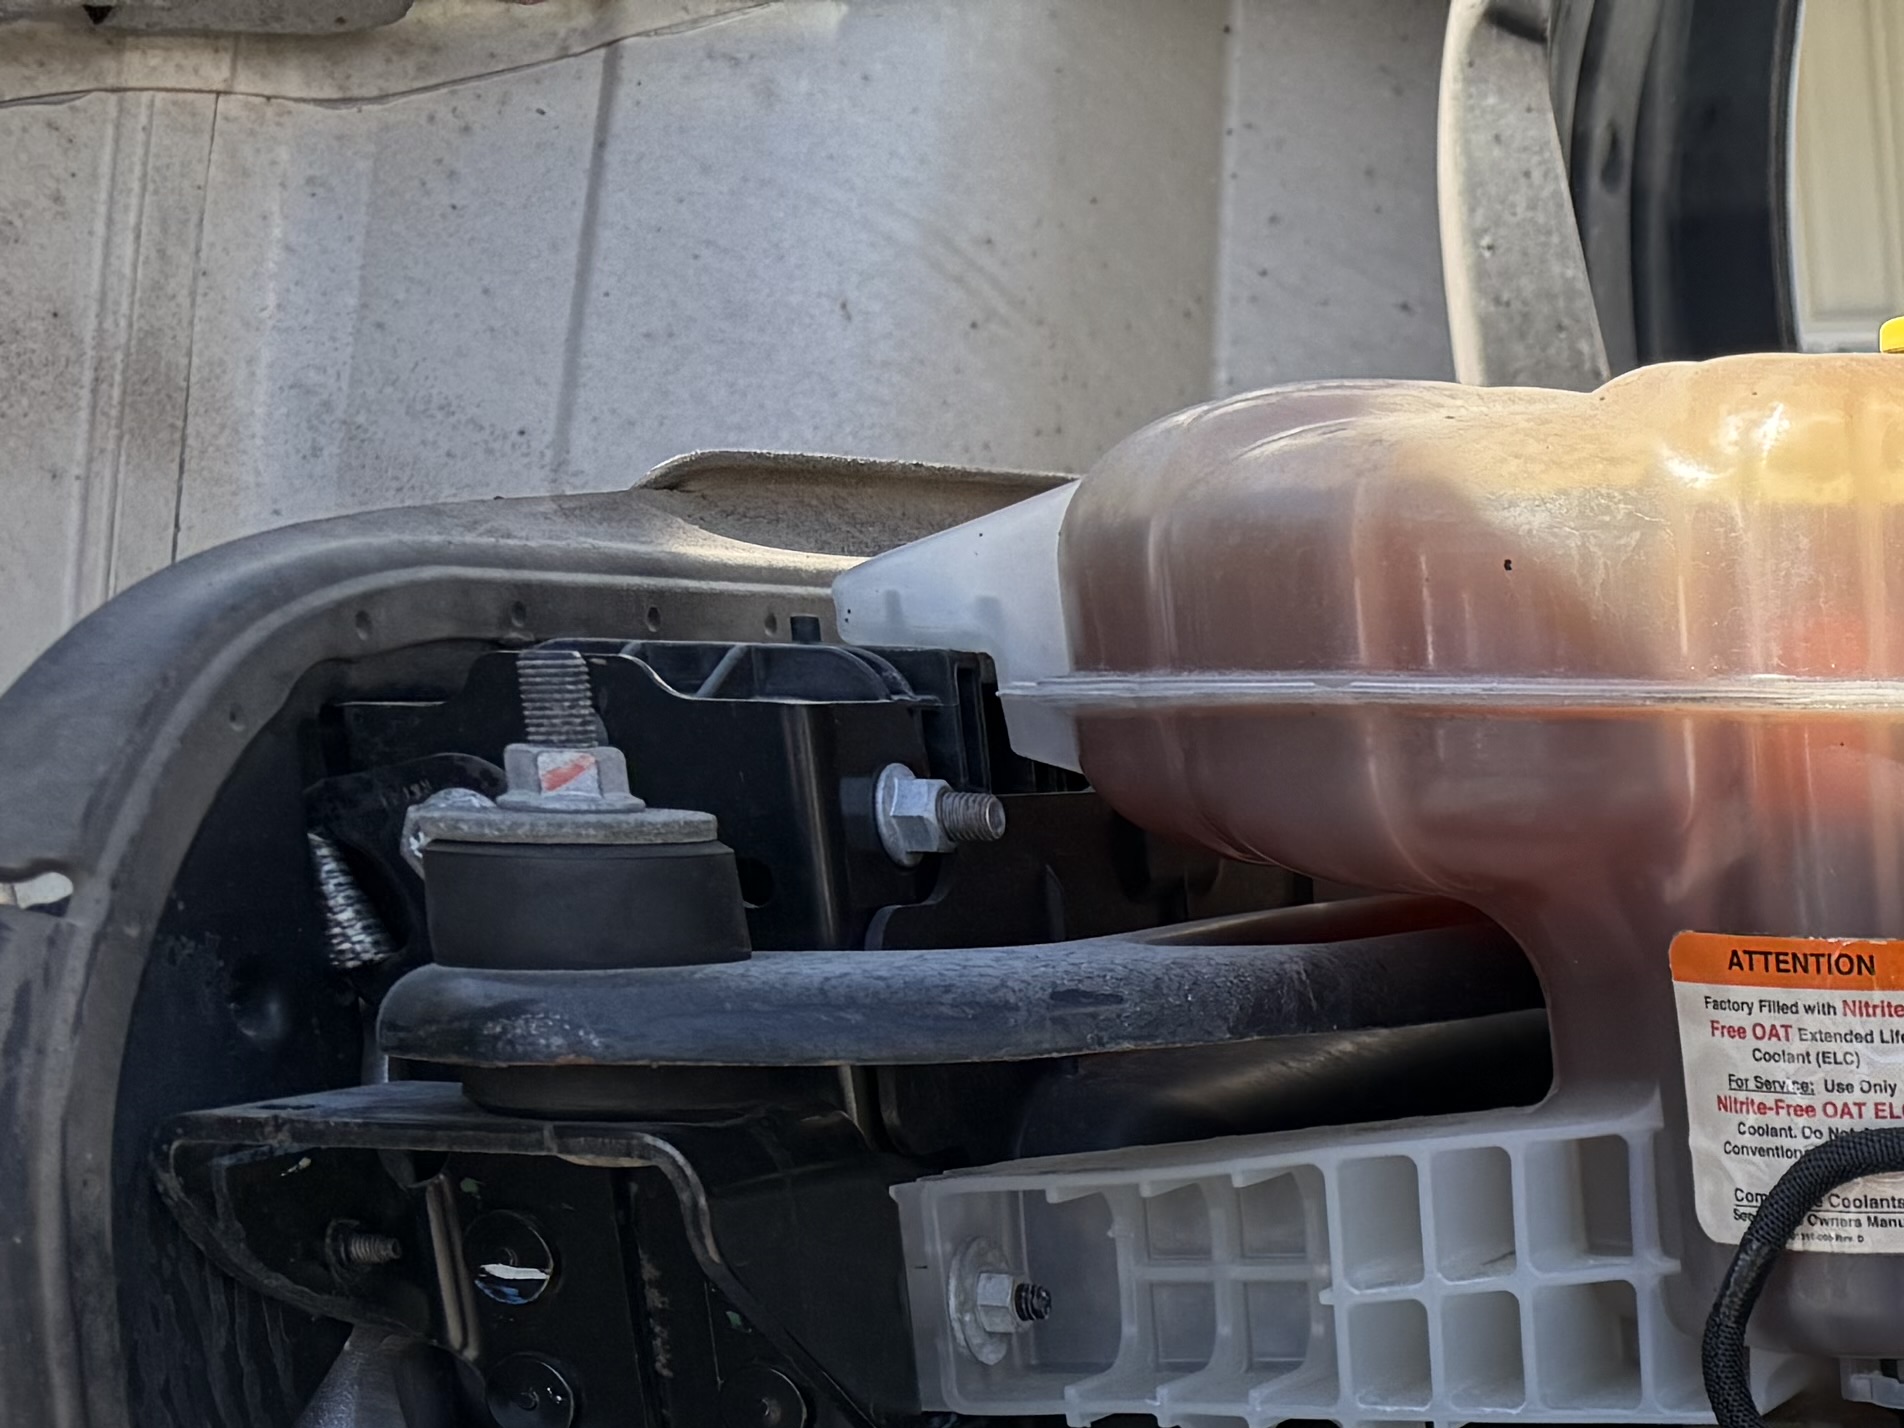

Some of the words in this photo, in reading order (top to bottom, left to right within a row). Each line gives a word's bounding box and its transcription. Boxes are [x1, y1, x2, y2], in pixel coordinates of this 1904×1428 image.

[1728, 949, 1876, 977] ATTENTION
[1704, 995, 1754, 1016] Factory
[1758, 999, 1799, 1016] Filled
[1803, 1001, 1838, 1017] with
[1710, 1020, 1747, 1040] Free
[1752, 1022, 1792, 1042] OAT
[1798, 1027, 1875, 1045] Extended
[1752, 1048, 1812, 1066] Coolant
[1815, 1050, 1861, 1069] (ELC)
[1728, 1074, 1750, 1091] For
[1824, 1079, 1854, 1095] Use
[1859, 1080, 1898, 1097] Only
[1717, 1095, 1817, 1119] Nitrite-Free
[1822, 1101, 1867, 1120] OAT
[1737, 1121, 1798, 1141] Coolant.
[1801, 1124, 1824, 1141] Do
[1808, 1213, 1863, 1228] Owners
